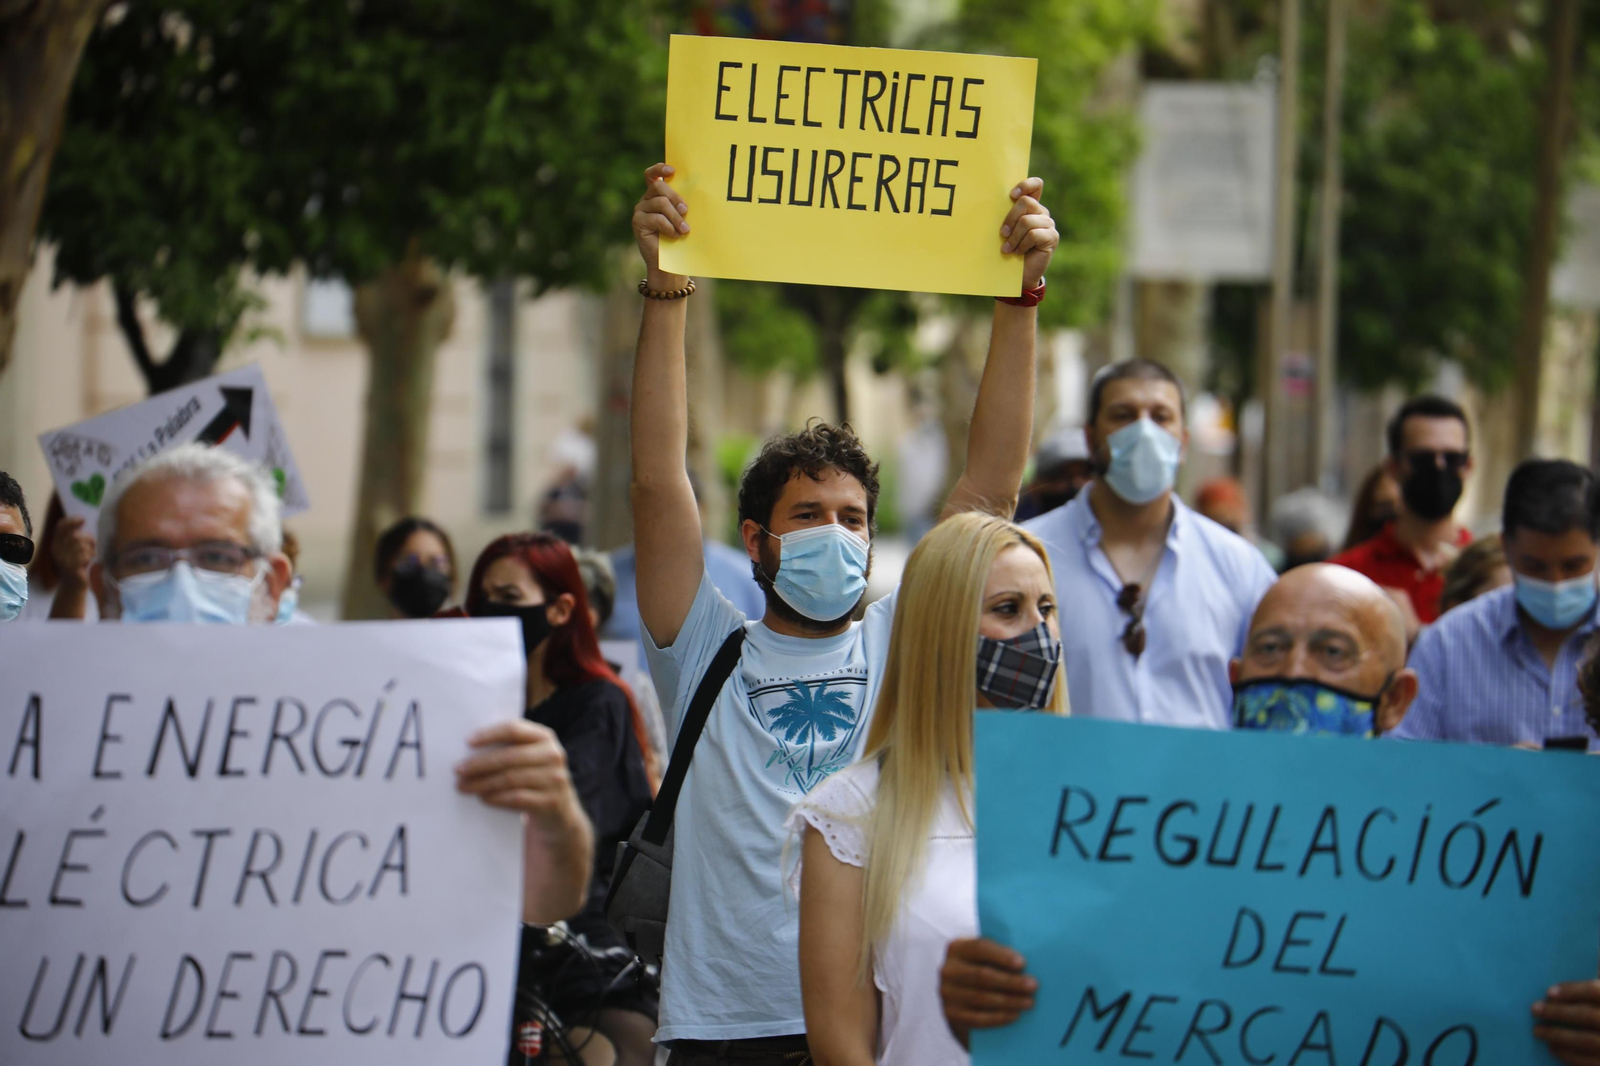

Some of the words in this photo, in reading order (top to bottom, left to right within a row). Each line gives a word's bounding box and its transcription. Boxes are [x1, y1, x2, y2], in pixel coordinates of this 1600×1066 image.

[714, 61, 985, 139] ELECTRICAS
[726, 144, 959, 217] USURERAS
[8, 693, 43, 782] A
[92, 678, 426, 781] ENERGÍA
[1049, 785, 1544, 899] REGULACIÓN
[1222, 906, 1357, 977] DEL
[17, 952, 137, 1042] UN
[158, 949, 488, 1041] DERECHO
[1060, 985, 1480, 1066] MERCADO
